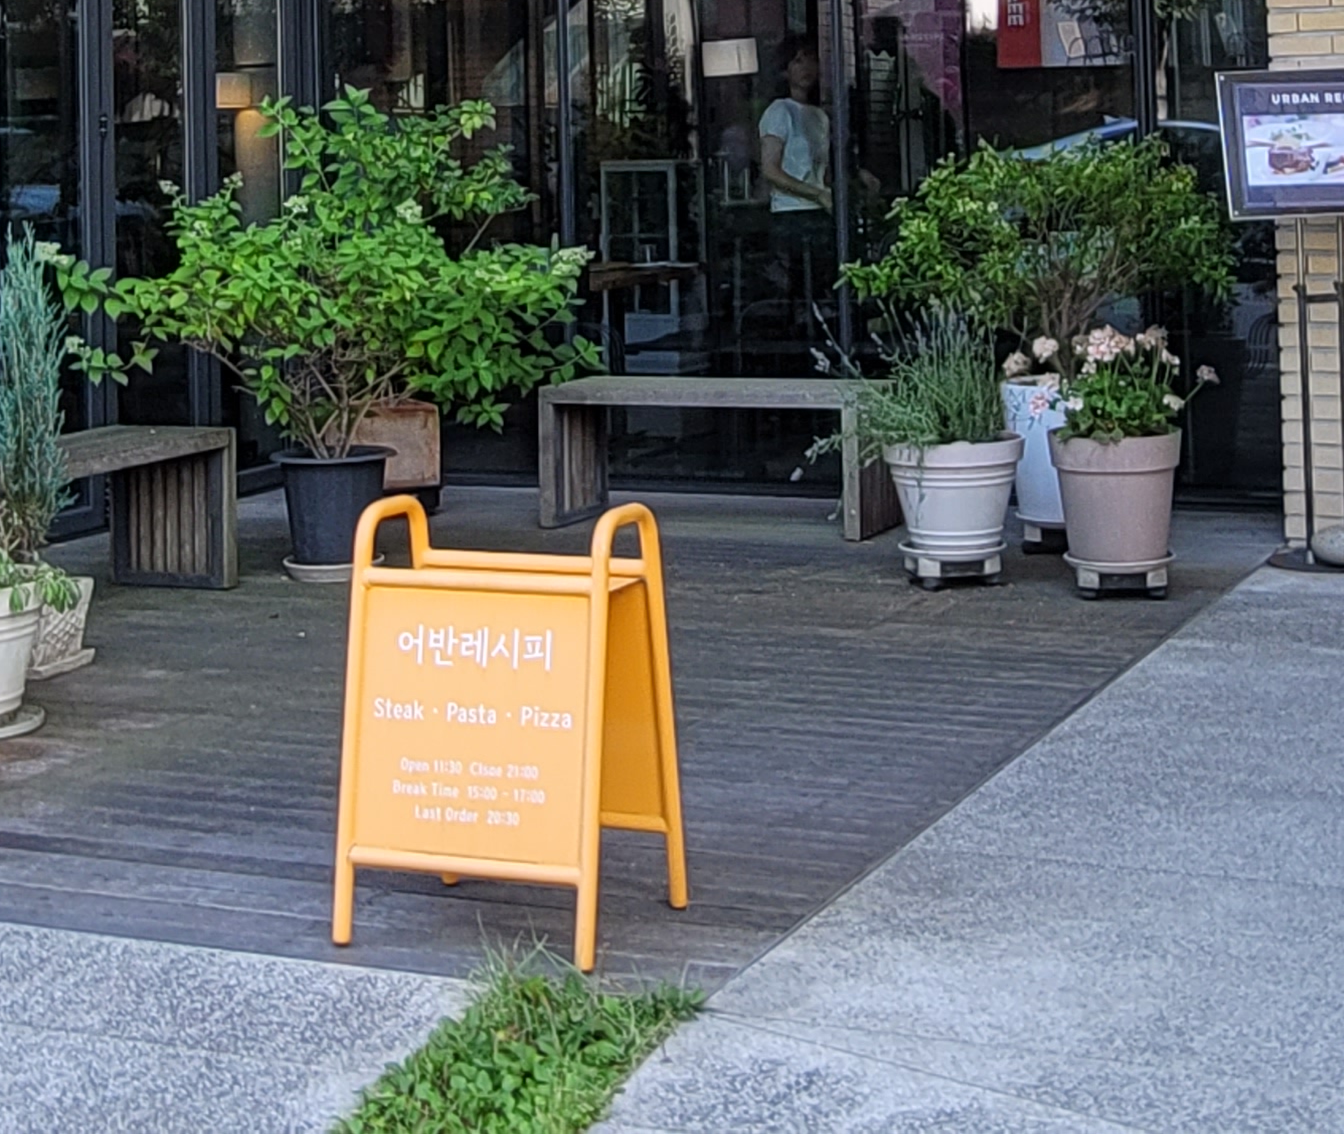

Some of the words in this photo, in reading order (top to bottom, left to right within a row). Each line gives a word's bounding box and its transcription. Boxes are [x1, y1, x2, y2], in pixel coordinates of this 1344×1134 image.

[1271, 92, 1320, 105] URBAN
[398, 623, 553, 672] 어반레시피
[373, 697, 424, 721] Steak
[446, 701, 496, 725] Pasta
[520, 705, 573, 730] Pizza
[400, 756, 430, 774] Open
[433, 759, 463, 776] 11:30
[506, 763, 539, 780] 21:00
[392, 779, 427, 795] Break
[431, 782, 460, 798] Time
[466, 785, 498, 801] 15:00
[513, 788, 546, 804] 17:00
[414, 804, 441, 822] Last
[445, 806, 479, 823] Order
[486, 810, 520, 826] 20:30
